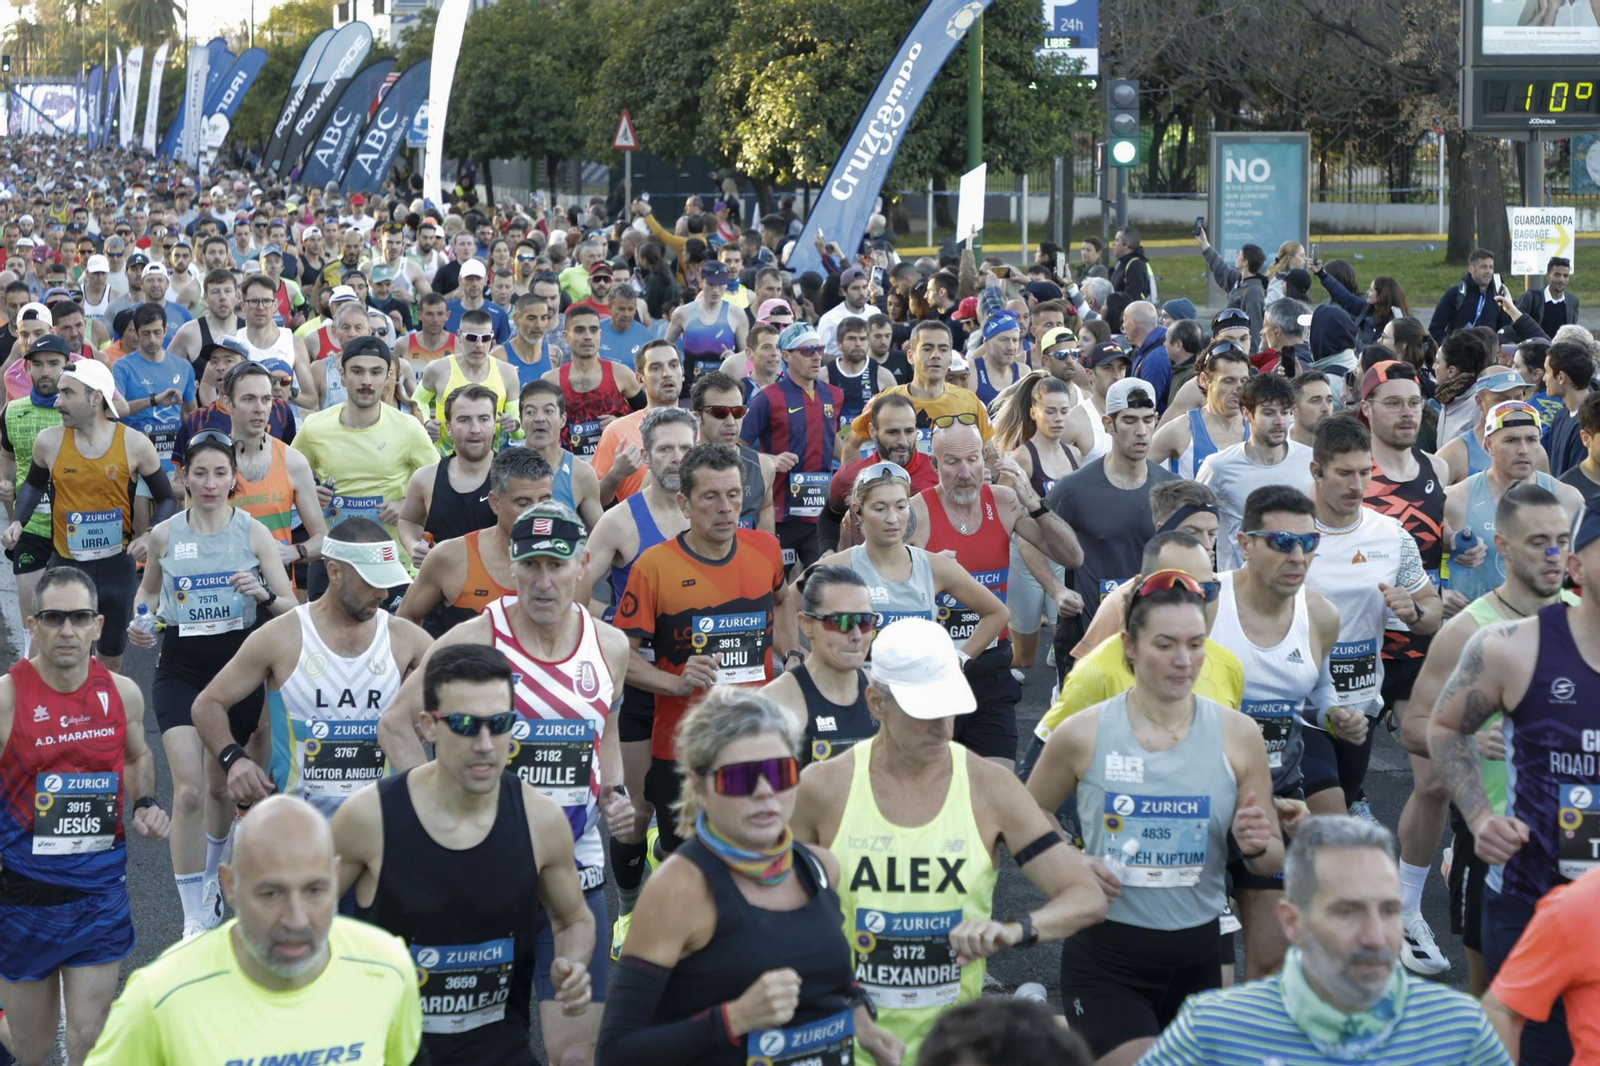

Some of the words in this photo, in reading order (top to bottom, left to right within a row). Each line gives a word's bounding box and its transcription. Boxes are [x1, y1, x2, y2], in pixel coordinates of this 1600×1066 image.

[1060, 18, 1083, 32] 24h
[1044, 37, 1071, 49] LIBRE
[295, 34, 369, 137] POWERADE
[831, 42, 922, 201] Cruzcampo
[1528, 117, 1556, 125] JCDecaux
[315, 106, 352, 169] ABC
[357, 106, 398, 175] ABC
[1225, 158, 1271, 183] NO
[1514, 215, 1573, 226] GUARDARROPA
[1514, 229, 1550, 239] BAGGAGE
[1513, 241, 1546, 251] SERVICE
[802, 497, 825, 506] YANN
[86, 513, 116, 522] ZURICH
[87, 528, 104, 536] 4663
[81, 537, 110, 549] URRA
[198, 594, 218, 604] 7578
[189, 606, 231, 621] SARAH
[719, 617, 758, 629] ZURICH
[719, 638, 741, 649] 3913
[1332, 643, 1370, 655] ZURICH
[1332, 664, 1355, 674] 3752
[1348, 672, 1376, 690] LIAM
[58, 727, 116, 743] MARATHON
[334, 725, 377, 735] ZURICH
[535, 724, 585, 736] ZURICH
[334, 747, 359, 758] 3767
[534, 750, 562, 762] 3182
[1550, 751, 1595, 776] ROAD
[304, 765, 343, 779] VÍCTOR
[345, 766, 384, 779] ANGULO
[517, 766, 576, 785] GUILLE
[68, 778, 110, 789] ZURICH
[66, 802, 91, 813] 3915
[1141, 801, 1198, 814] ZURICH
[53, 814, 101, 835] JESÚS
[1141, 828, 1171, 840] 4835
[1156, 852, 1205, 866] KIPTUM
[849, 856, 968, 895] ALEX
[892, 917, 951, 931] ZURICH
[446, 946, 503, 964] ZURICH
[893, 945, 925, 960] 3172
[855, 963, 961, 986] ALEXANDRE
[444, 975, 478, 990] 3659
[791, 1019, 845, 1048] ZURICH
